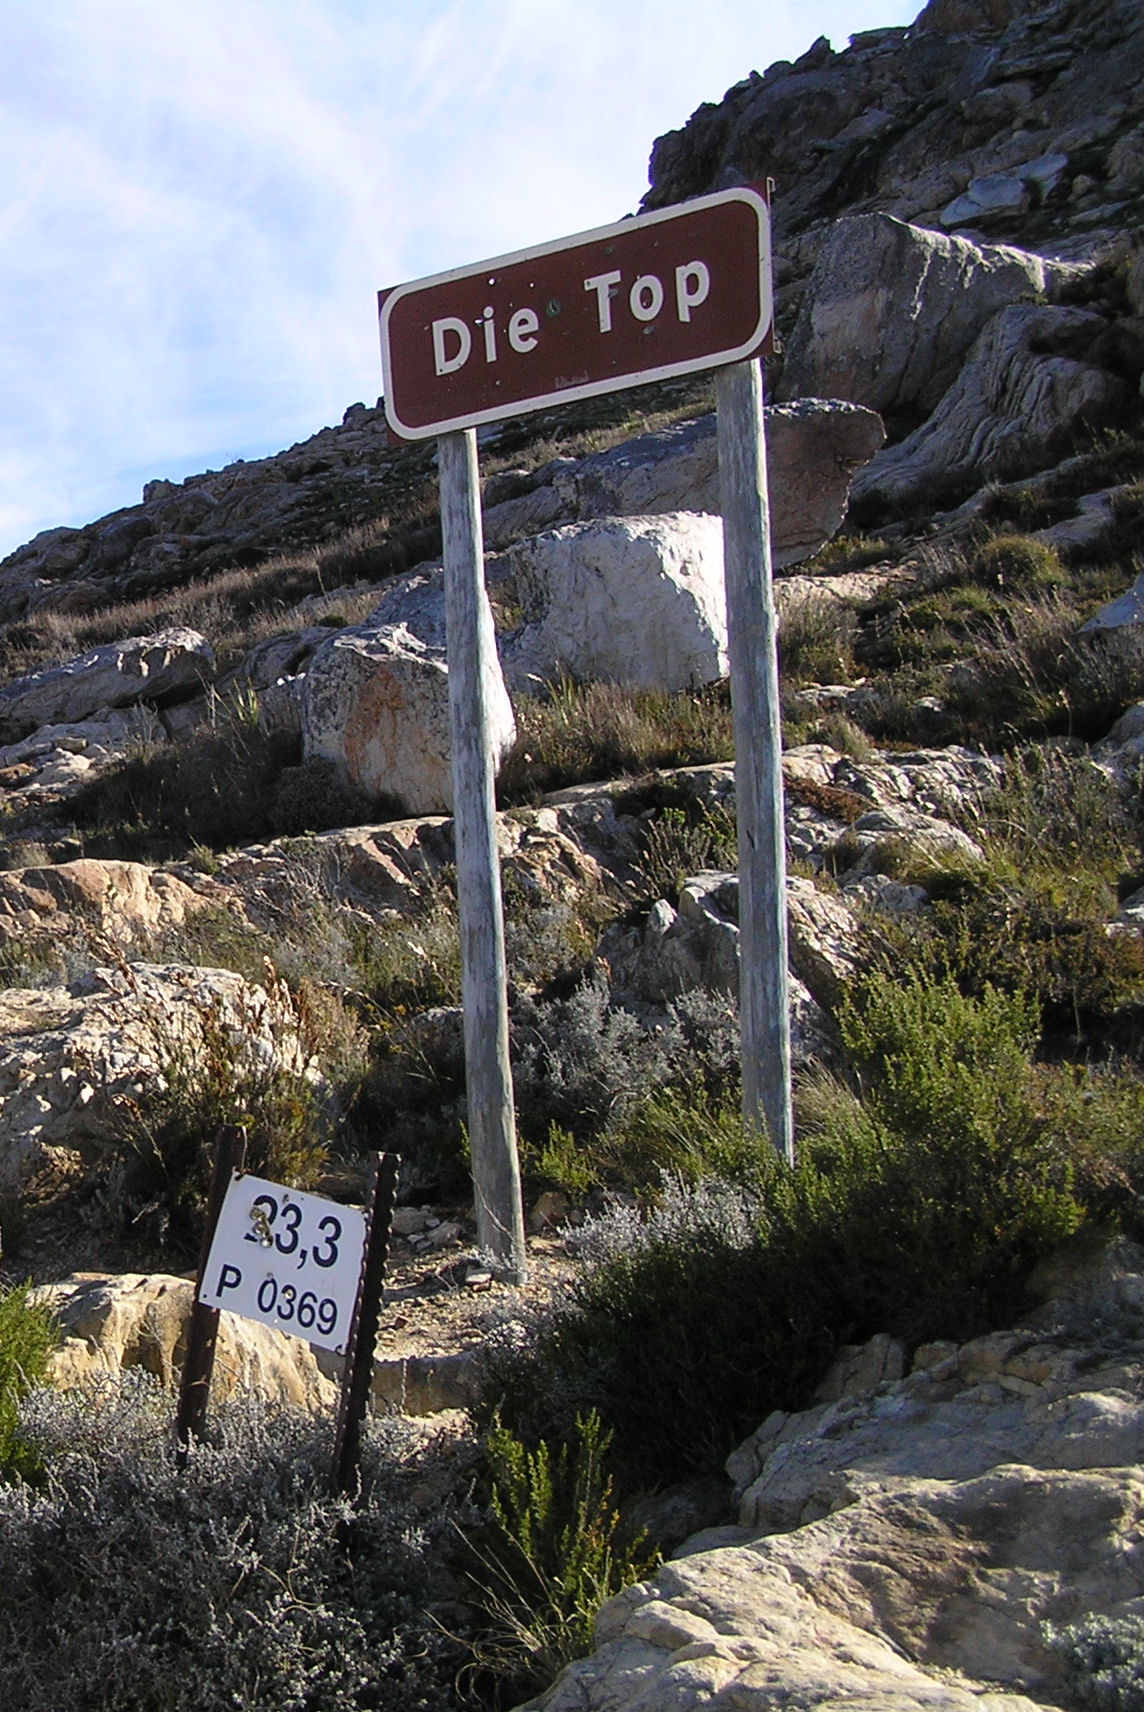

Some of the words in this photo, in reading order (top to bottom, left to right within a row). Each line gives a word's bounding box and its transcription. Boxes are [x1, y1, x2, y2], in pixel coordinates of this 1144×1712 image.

[431, 306, 539, 376] Die
[584, 260, 710, 333] Top
[216, 1264, 242, 1297] P
[257, 1277, 337, 1335] 0369
